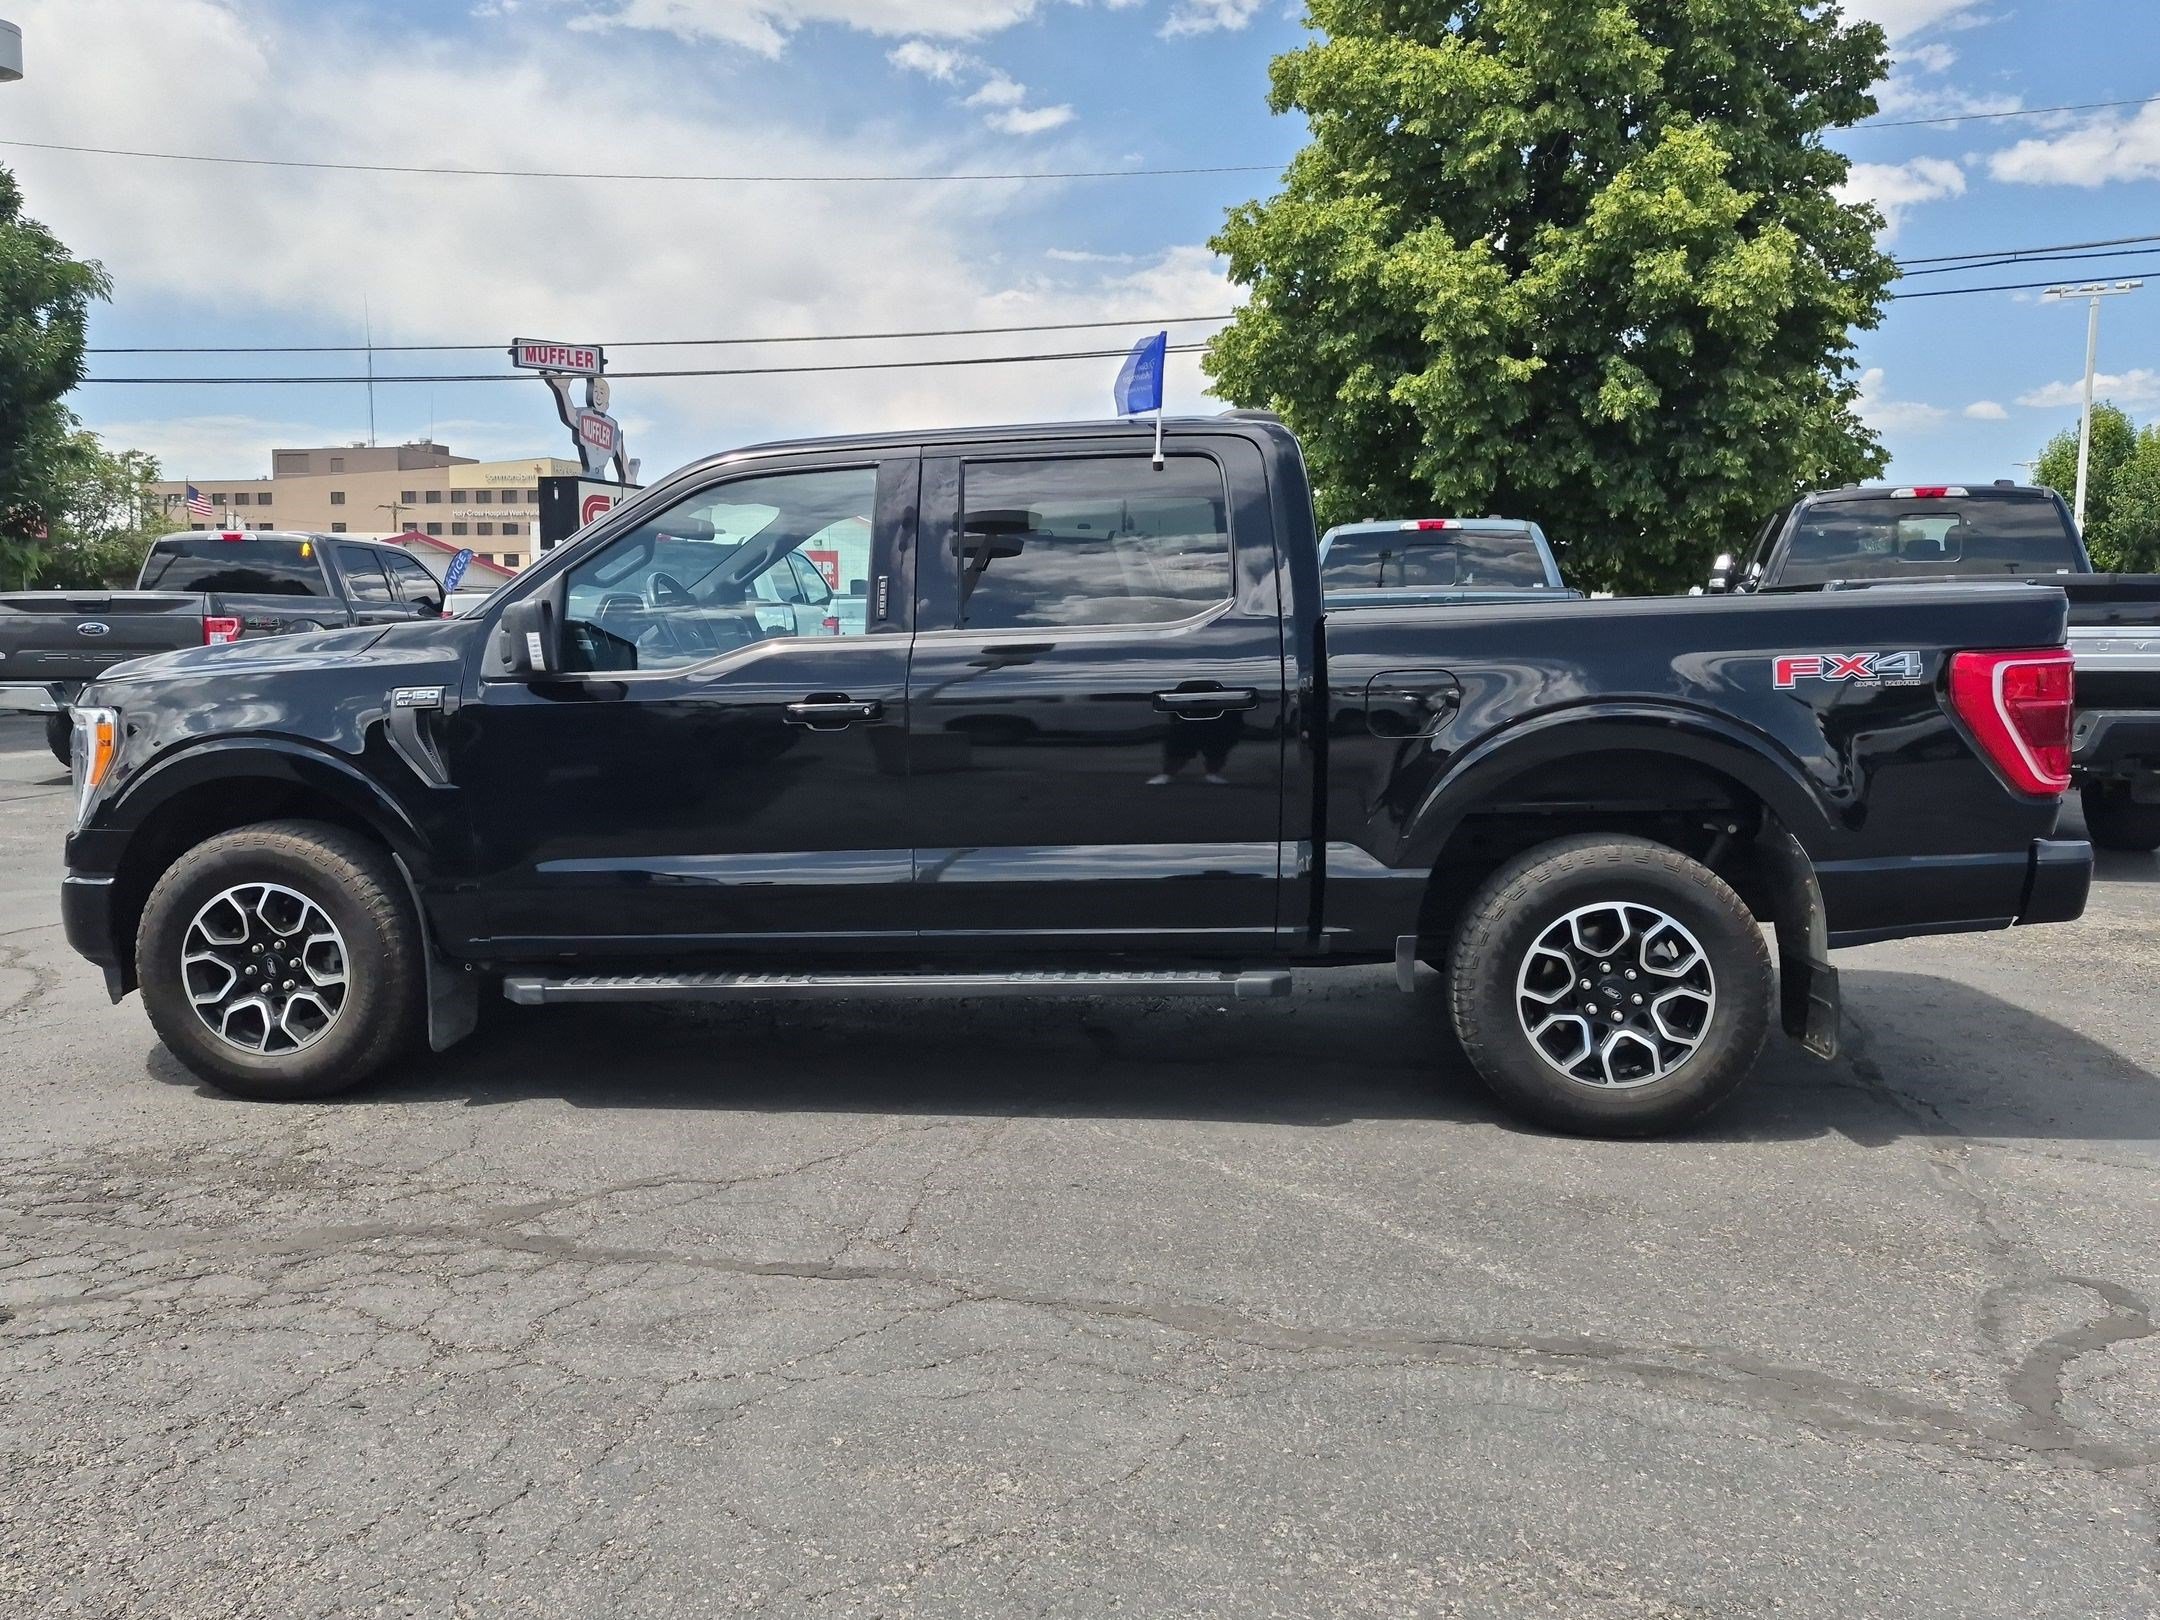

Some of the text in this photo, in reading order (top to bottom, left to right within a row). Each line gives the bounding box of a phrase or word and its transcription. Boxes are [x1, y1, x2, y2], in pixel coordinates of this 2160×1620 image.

[525, 346, 594, 368] MUFFLER
[582, 418, 611, 447] MUFFLER
[452, 509, 466, 518] Holy
[486, 509, 508, 518] Hospital
[1772, 651, 1923, 690] FX4
